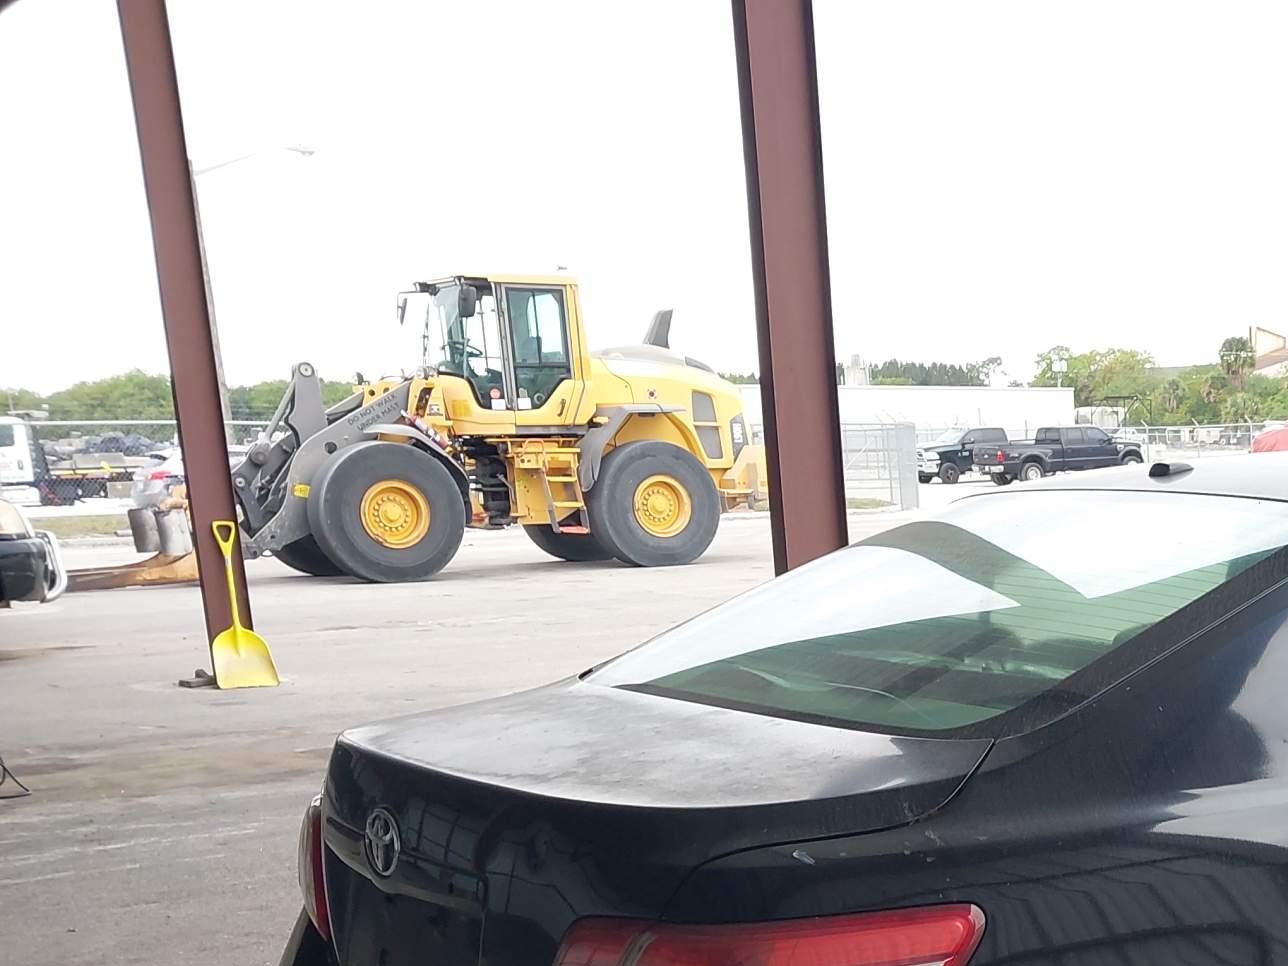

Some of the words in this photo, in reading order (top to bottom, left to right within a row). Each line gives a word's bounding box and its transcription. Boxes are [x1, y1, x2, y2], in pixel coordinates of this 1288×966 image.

[348, 414, 360, 425] DO
[360, 405, 376, 417] NOT
[375, 394, 396, 408] WALK
[357, 413, 381, 431] UNDER
[381, 401, 400, 417] MAST
